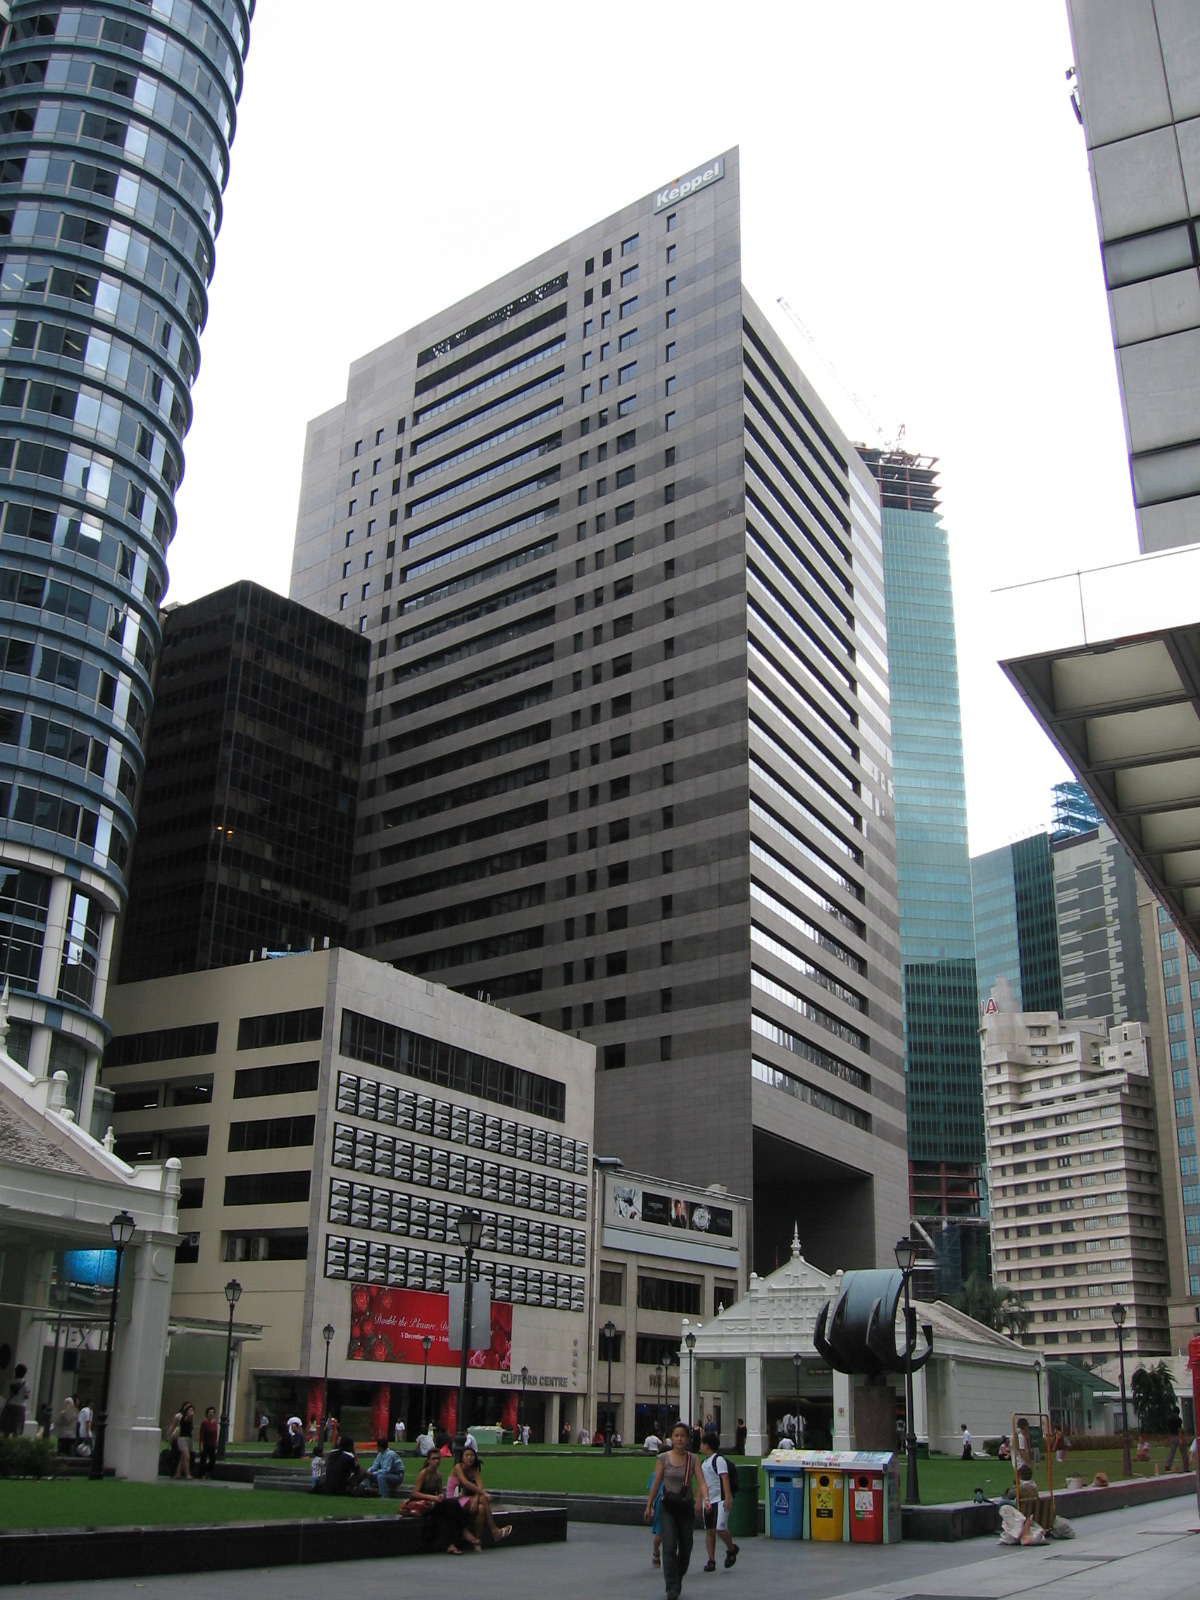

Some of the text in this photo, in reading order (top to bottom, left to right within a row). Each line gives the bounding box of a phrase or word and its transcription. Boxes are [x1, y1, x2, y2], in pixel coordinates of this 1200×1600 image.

[656, 161, 720, 207] Keppel
[500, 1373, 568, 1388] CLIFFORD CENTRE
